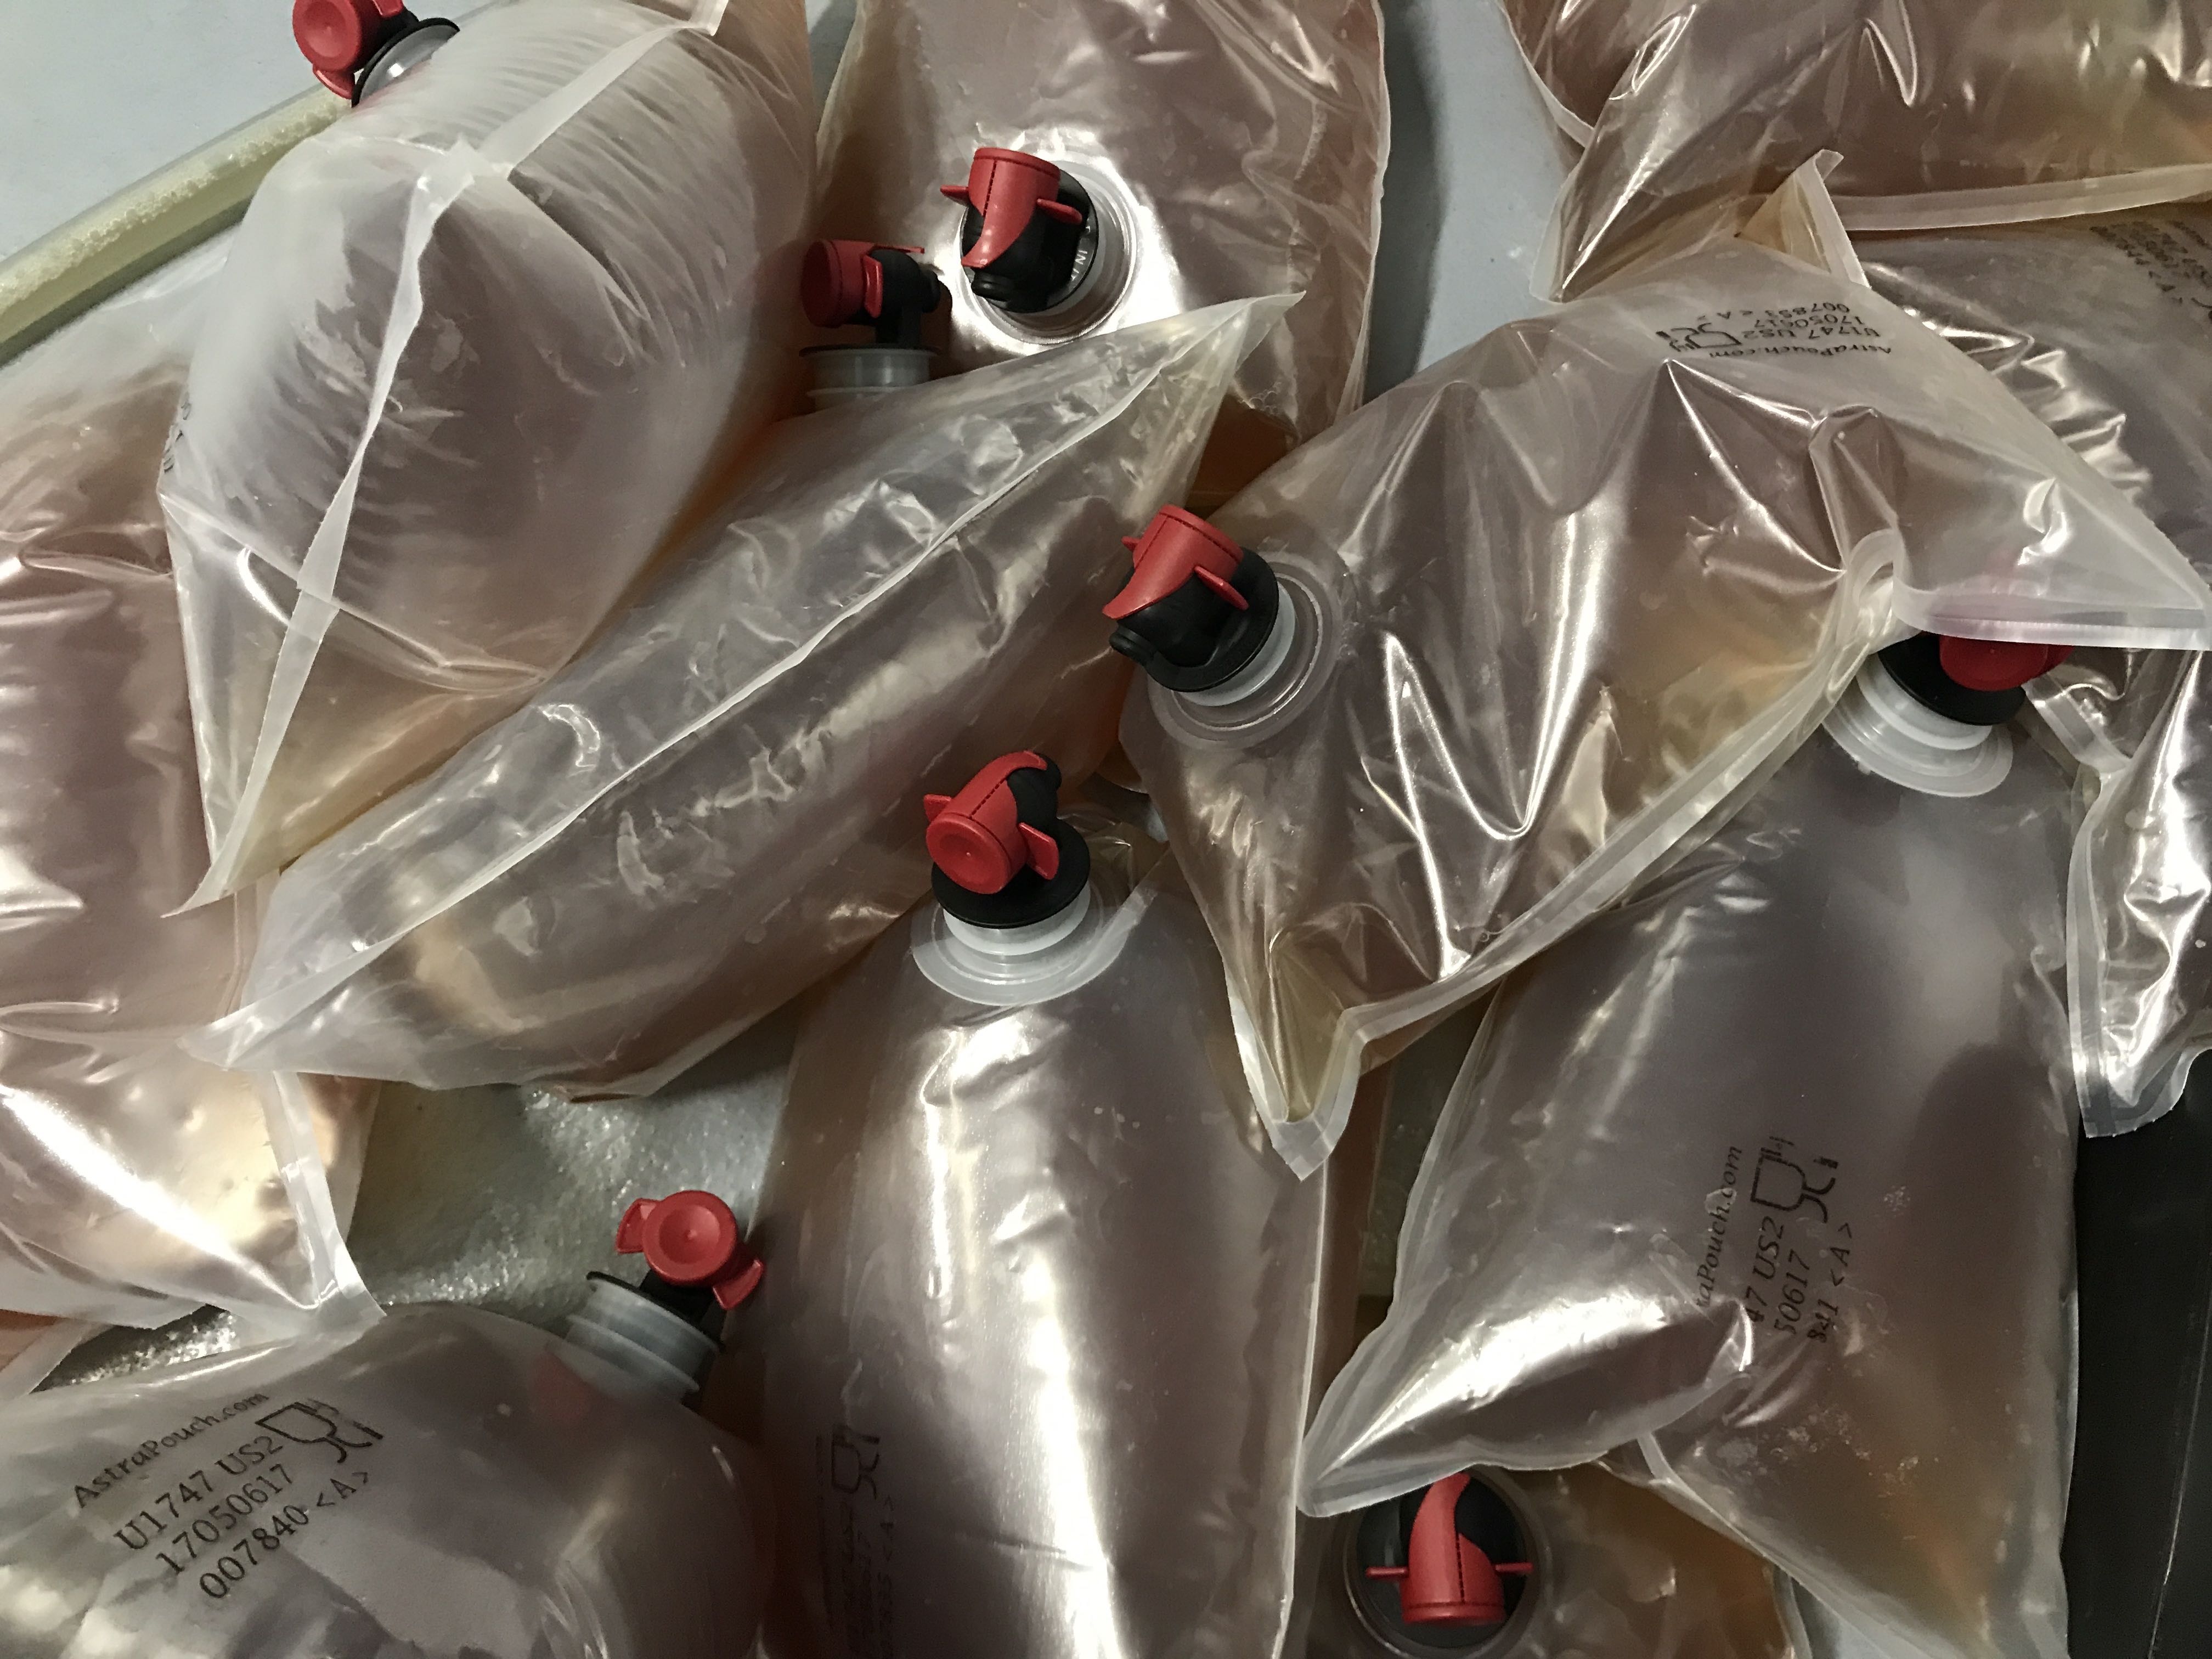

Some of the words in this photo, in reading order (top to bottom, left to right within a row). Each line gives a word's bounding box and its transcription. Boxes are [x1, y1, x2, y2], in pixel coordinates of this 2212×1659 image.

[1752, 1215, 1784, 1280] US2
[1773, 1249, 1810, 1335] 50617
[73, 1392, 270, 1509] AstraPouch.com
[114, 1469, 216, 1551] U1747
[214, 1434, 284, 1476] US2
[155, 1463, 296, 1575] 17050617
[199, 1504, 309, 1599] 007840
